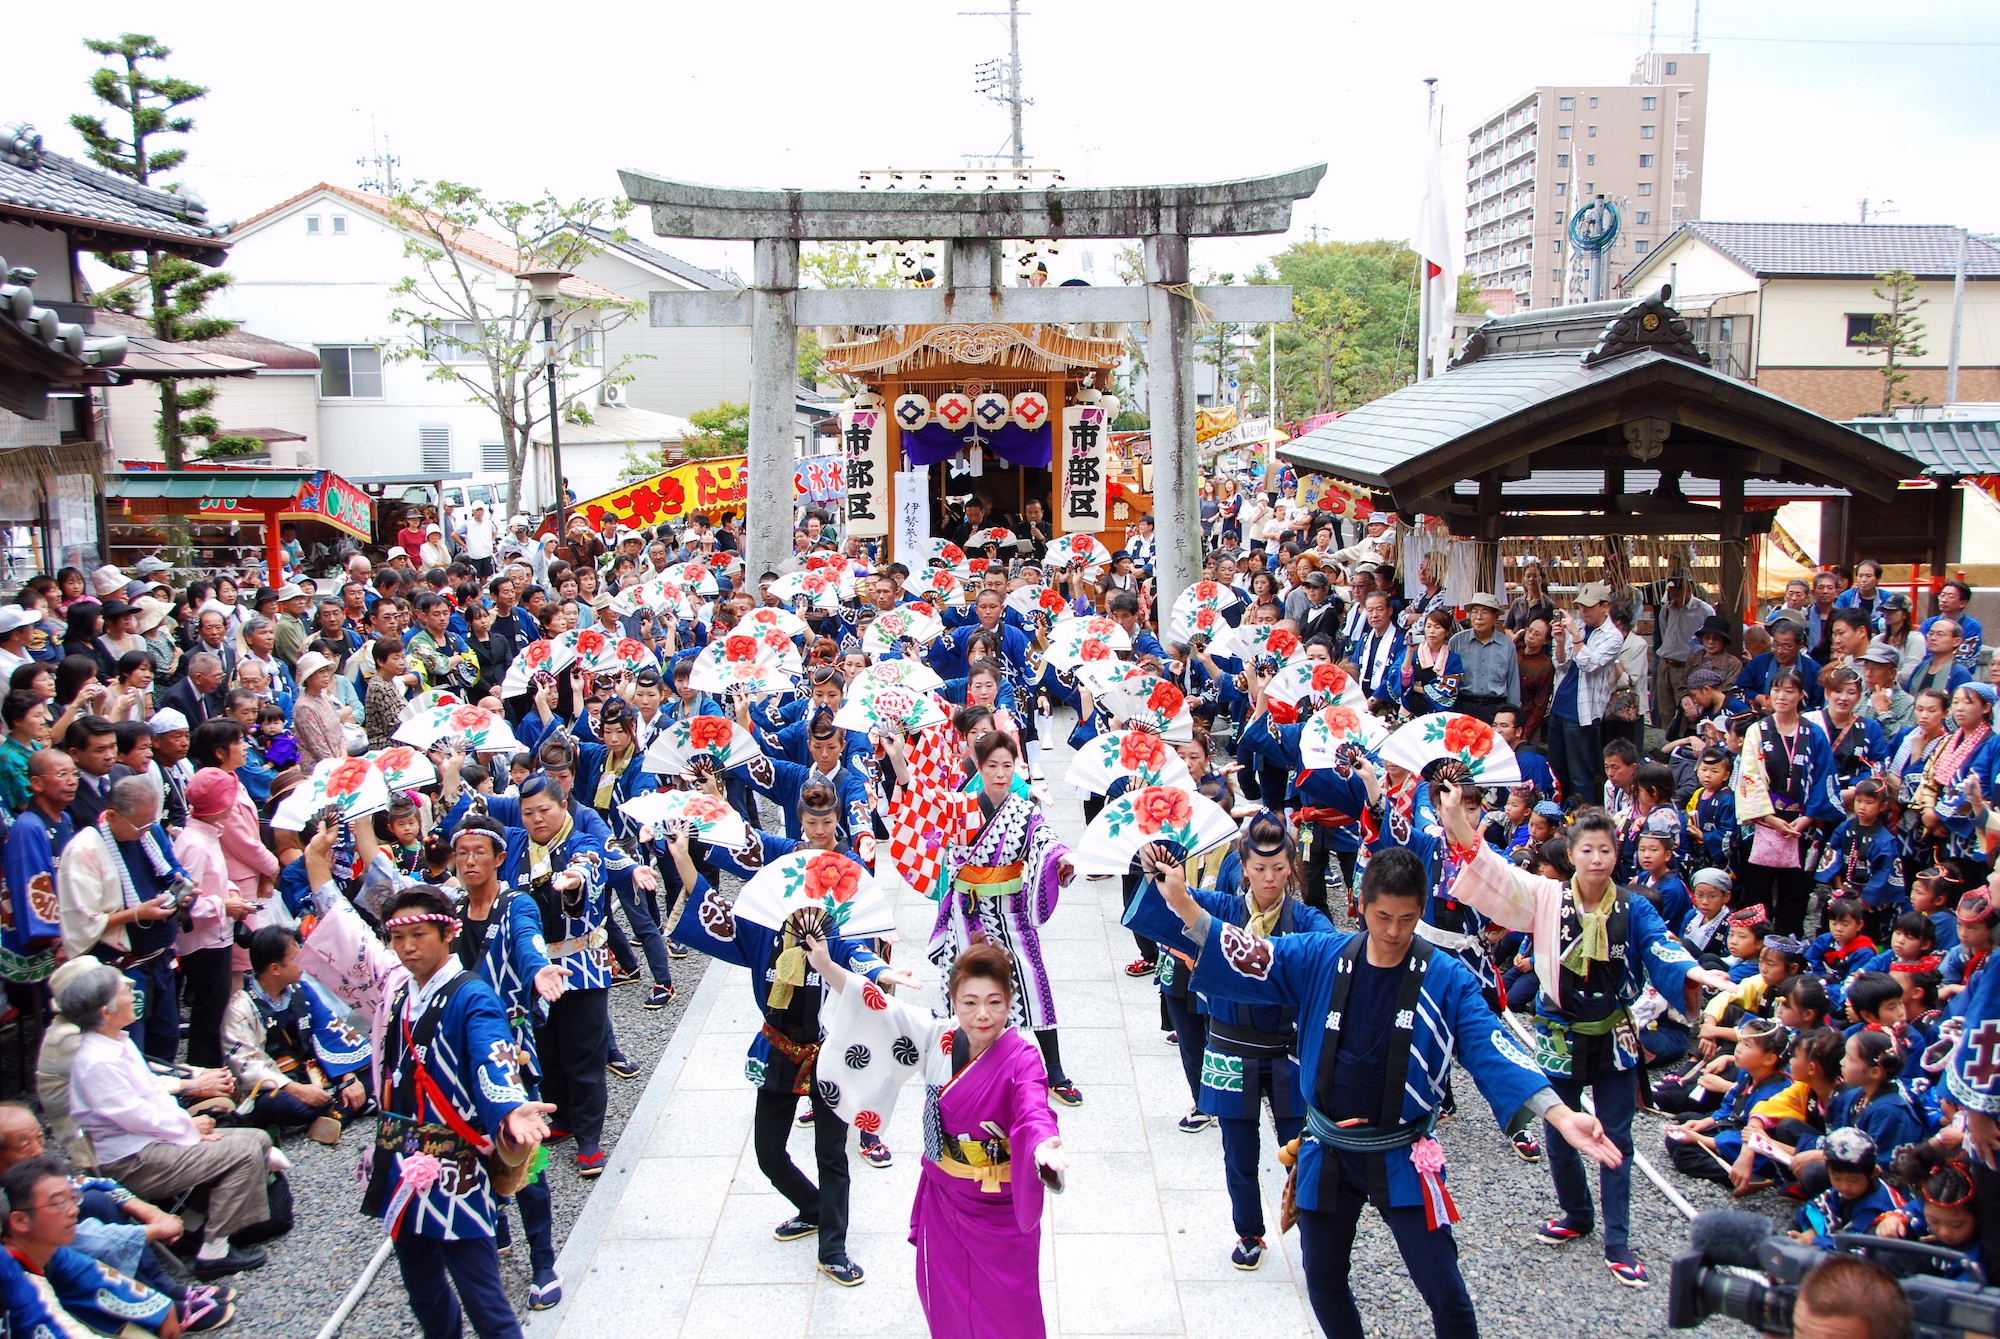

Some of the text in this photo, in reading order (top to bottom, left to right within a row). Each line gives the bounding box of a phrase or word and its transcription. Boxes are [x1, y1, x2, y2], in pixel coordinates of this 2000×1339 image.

[844, 424, 876, 521] 市部区
[1068, 420, 1100, 519] 市部区
[1560, 886, 1576, 941] さかえ
[805, 971, 822, 987] 組
[1325, 956, 1353, 1031] い 組
[1395, 956, 1428, 1030] い 組
